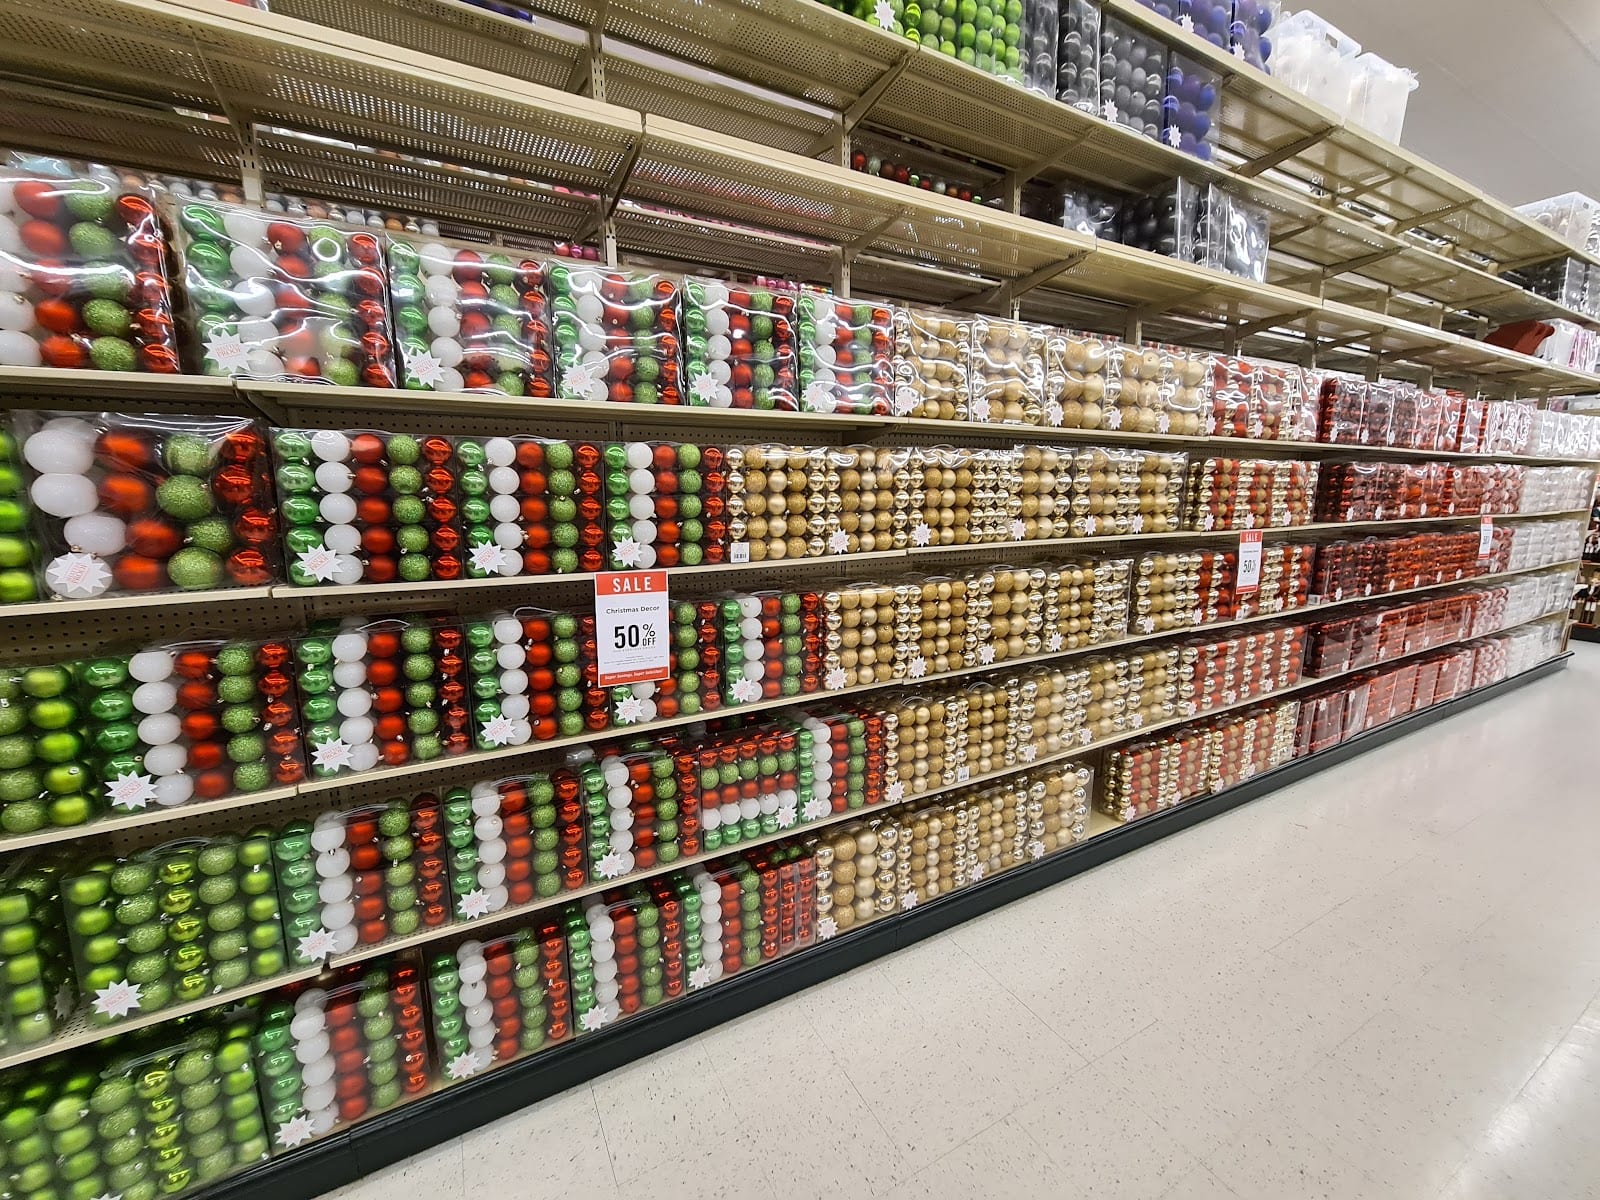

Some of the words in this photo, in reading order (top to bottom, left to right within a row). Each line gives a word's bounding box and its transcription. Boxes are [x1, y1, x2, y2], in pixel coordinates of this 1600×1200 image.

[1245, 532, 1258, 542] SALE
[613, 576, 652, 593] SALE
[606, 606, 639, 615] Christmas
[642, 637, 657, 647] OFF
